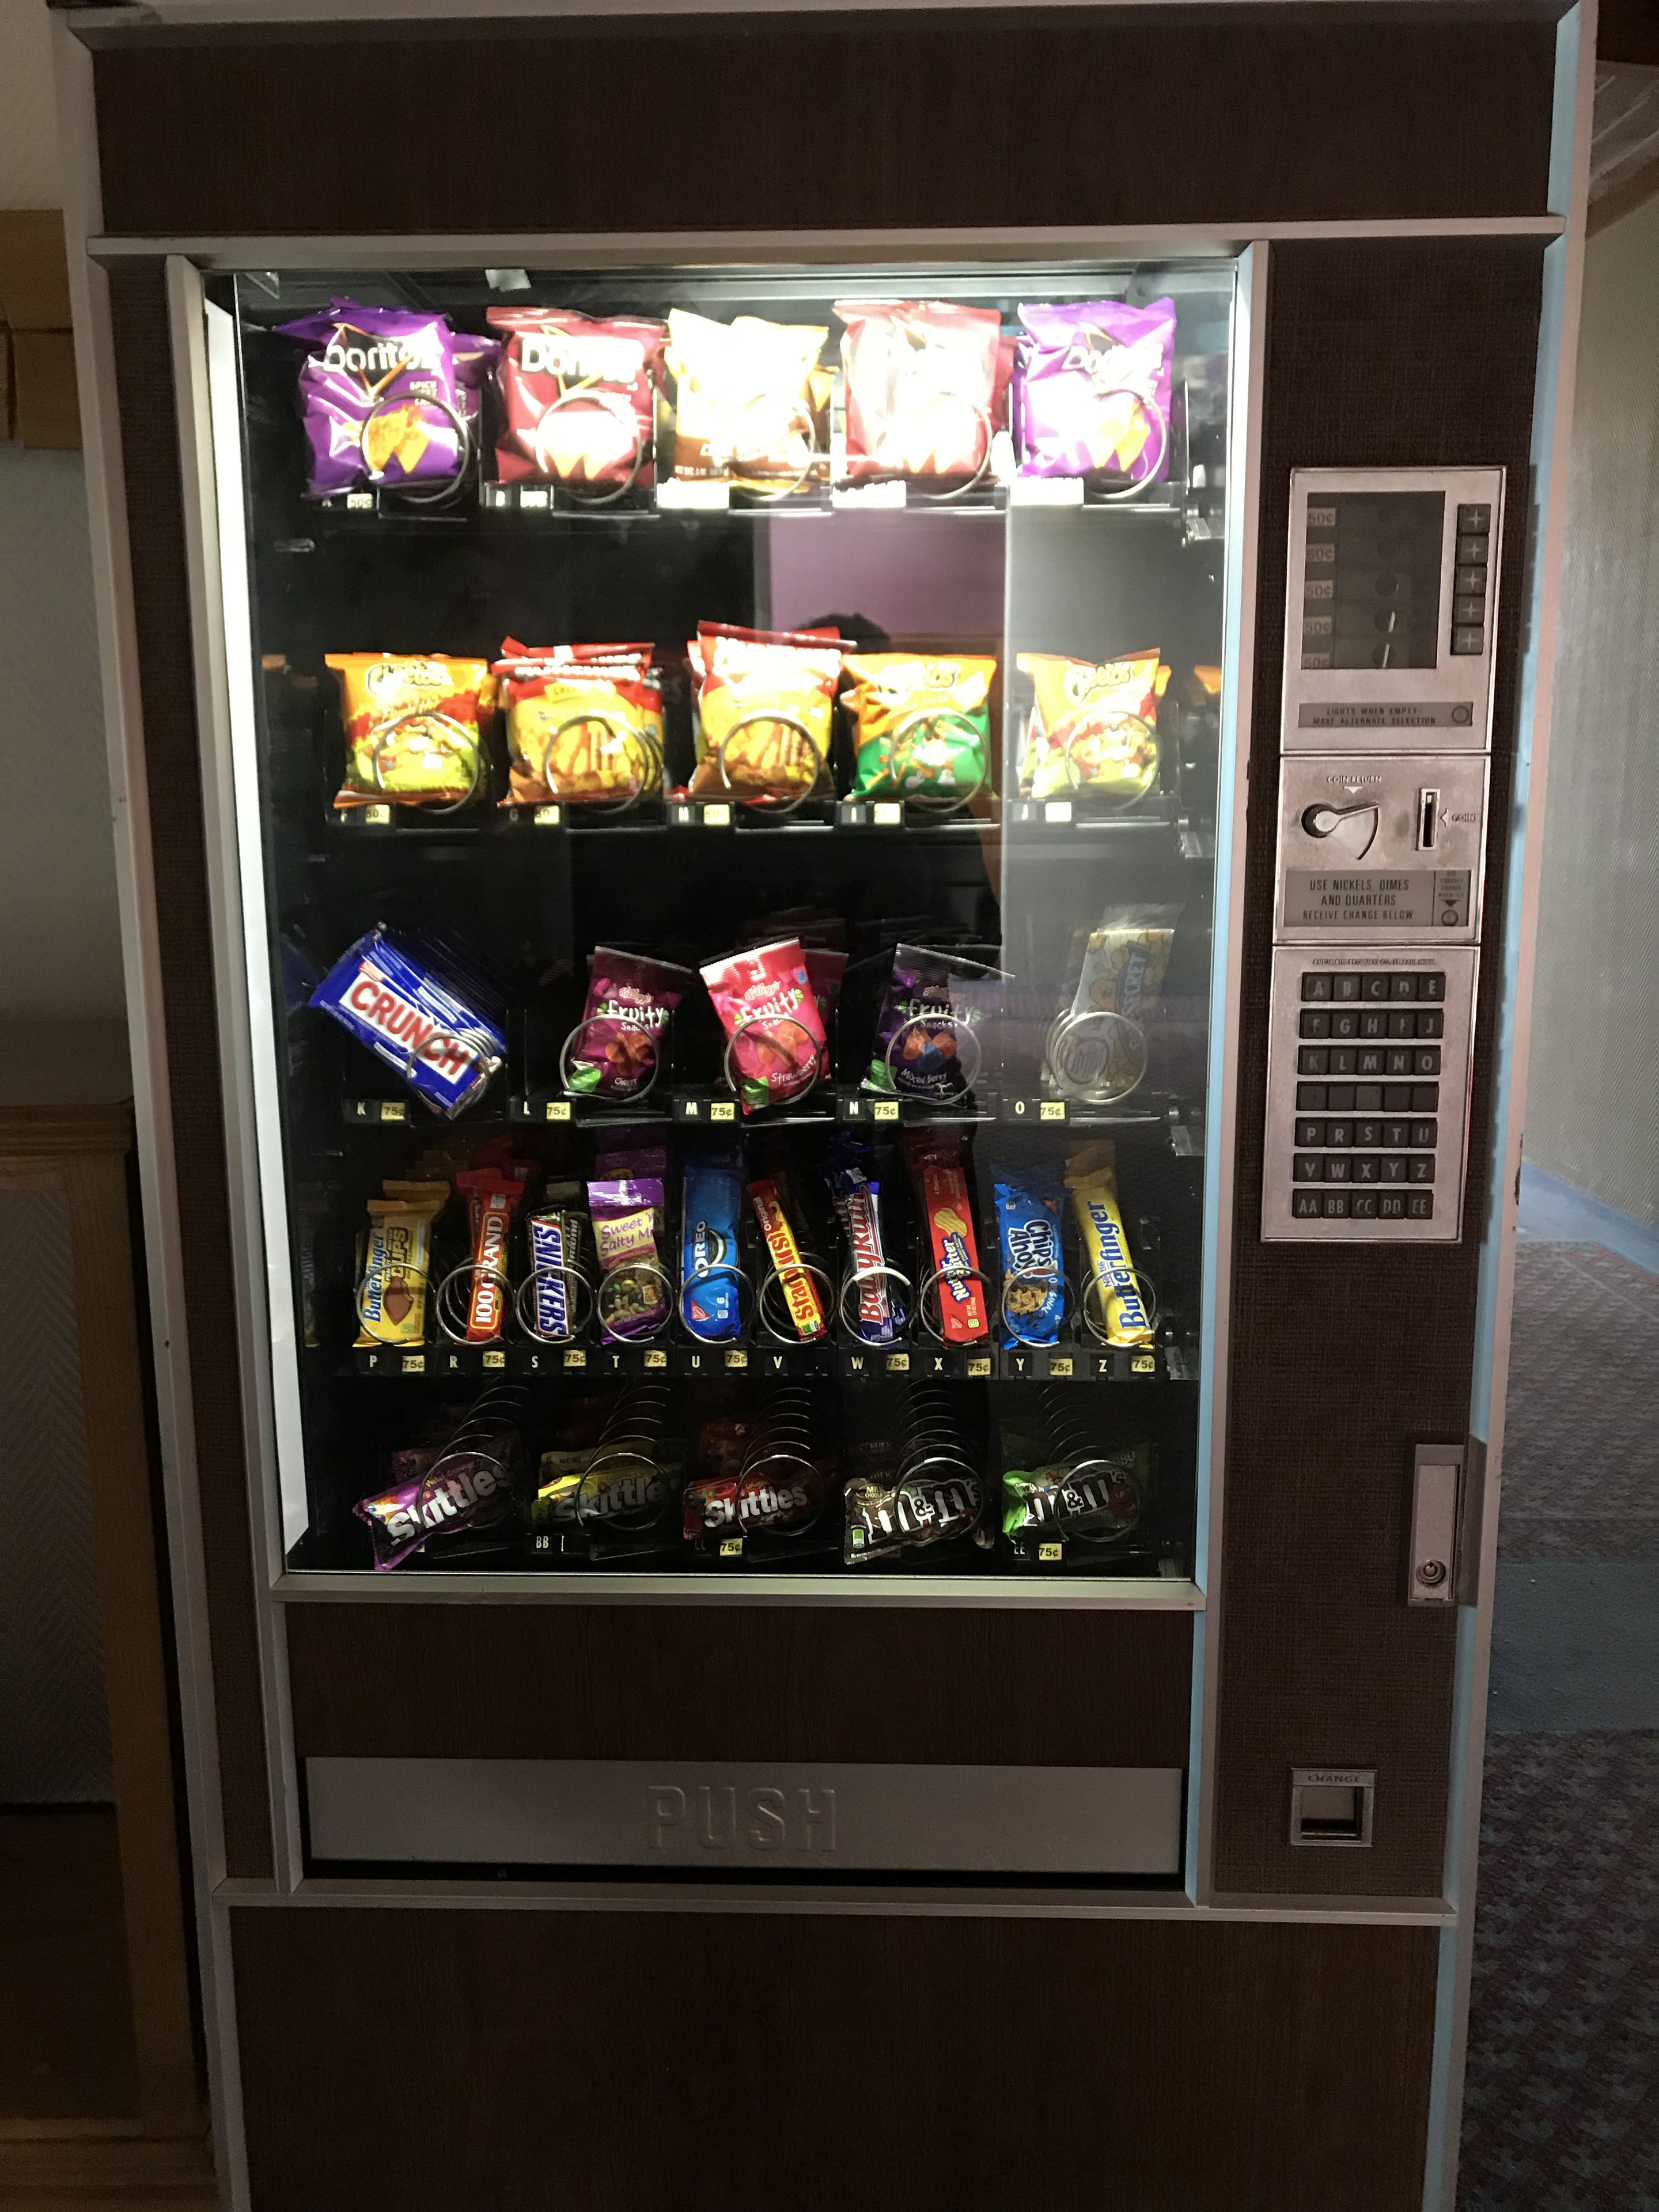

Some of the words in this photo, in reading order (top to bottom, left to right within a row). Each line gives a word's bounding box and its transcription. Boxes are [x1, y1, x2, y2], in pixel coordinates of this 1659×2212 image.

[324, 342, 435, 374] Dorito
[1309, 512, 1334, 523] 50¢
[1308, 549, 1333, 559] 50¢
[1306, 585, 1331, 596] 50¢
[1305, 622, 1331, 632] 50¢
[1070, 662, 1132, 705] Cheetos
[1351, 775, 1381, 783] RETURN
[1310, 879, 1328, 891] USE
[1380, 879, 1410, 891] DIMES
[1321, 895, 1341, 906] AND
[1345, 895, 1396, 906] QUARTERS
[1303, 910, 1338, 920] RECEIVE
[1343, 910, 1378, 920] CHANGE
[1383, 910, 1414, 920] BELOW
[744, 980, 781, 1001] Kellogg's
[1313, 980, 1323, 995] A
[1343, 980, 1351, 995] B
[1371, 980, 1380, 995] C
[1399, 980, 1410, 995] D
[1428, 980, 1437, 995] E
[350, 980, 470, 1075] CRUNCH
[621, 1021, 650, 1032] Snacs
[762, 1013, 790, 1030] Snac
[1313, 1018, 1320, 1033] F
[1340, 1018, 1350, 1033] G
[1368, 1018, 1378, 1033] H
[1400, 1018, 1405, 1033] I
[1426, 1018, 1434, 1033] J
[771, 1054, 816, 1084] Strawberry
[1309, 1055, 1319, 1070] K
[1339, 1055, 1346, 1070] L
[1363, 1055, 1377, 1070] M
[1393, 1055, 1404, 1070] N
[1422, 1055, 1433, 1070] O
[614, 1077, 638, 1086] Cherry
[901, 1068, 926, 1084] Mixed
[927, 1071, 948, 1084] Berry
[357, 1101, 366, 1116] K
[524, 1101, 531, 1115] L
[547, 1106, 567, 1116] 75¢
[685, 1101, 698, 1115] M
[711, 1107, 732, 1116] 75¢
[849, 1101, 858, 1115] N
[875, 1106, 896, 1116] 75¢
[1015, 1101, 1025, 1115] O
[1040, 1107, 1061, 1116] 75¢
[1306, 1127, 1316, 1142] P
[1335, 1127, 1344, 1142] R
[1365, 1127, 1373, 1142] S
[1392, 1127, 1401, 1142] T
[1419, 1127, 1429, 1142] U
[1305, 1163, 1315, 1178] V
[1331, 1163, 1345, 1178] W
[1361, 1163, 1372, 1178] X
[1389, 1163, 1399, 1178] Y
[1417, 1163, 1427, 1178] Z
[1299, 1199, 1317, 1214] AA
[1328, 1199, 1344, 1214] BB
[1357, 1199, 1372, 1214] CC
[1384, 1199, 1401, 1214] DD
[1412, 1199, 1427, 1214] EE
[752, 1196, 772, 1232] Original
[601, 1218, 643, 1240] Sweet
[569, 1219, 578, 1262] mond
[600, 1234, 634, 1256] Salty
[638, 1226, 654, 1240] Mi
[1026, 1221, 1052, 1267] Chips
[391, 1228, 407, 1278] CUPS
[482, 1215, 504, 1290] GRAND
[694, 1220, 709, 1278] OREO
[1088, 1202, 1146, 1328] Butterfinger
[363, 1233, 389, 1323] Butternger
[767, 1230, 815, 1321] Starburst
[940, 1261, 969, 1301] Nutr
[1099, 1260, 1112, 1288] Netlé
[475, 1290, 495, 1324] 100
[369, 1355, 377, 1368] P
[403, 1359, 425, 1370] 75¢
[449, 1355, 458, 1368] R
[532, 1355, 539, 1368] S
[565, 1354, 586, 1364] 75¢
[612, 1355, 620, 1368] T
[646, 1354, 667, 1364] 75¢
[692, 1355, 700, 1368] U
[773, 1356, 782, 1369] V
[851, 1357, 864, 1369] W
[887, 1357, 908, 1367] 75¢
[934, 1358, 943, 1370] X
[1016, 1358, 1025, 1371] Y
[1099, 1359, 1107, 1373] Z
[1133, 1359, 1154, 1369] 75¢
[968, 1362, 989, 1373] 75¢
[1050, 1363, 1071, 1373] 75¢
[387, 1465, 509, 1547] Skittles
[704, 1486, 808, 1528] Skittles
[536, 1536, 549, 1549] BB
[721, 1543, 741, 1552] 75¢
[1014, 1542, 1026, 1555] EE
[1039, 1547, 1059, 1556] 75¢
[1307, 1774, 1361, 1783] CHANGE
[647, 1786, 836, 1851] PUSH
